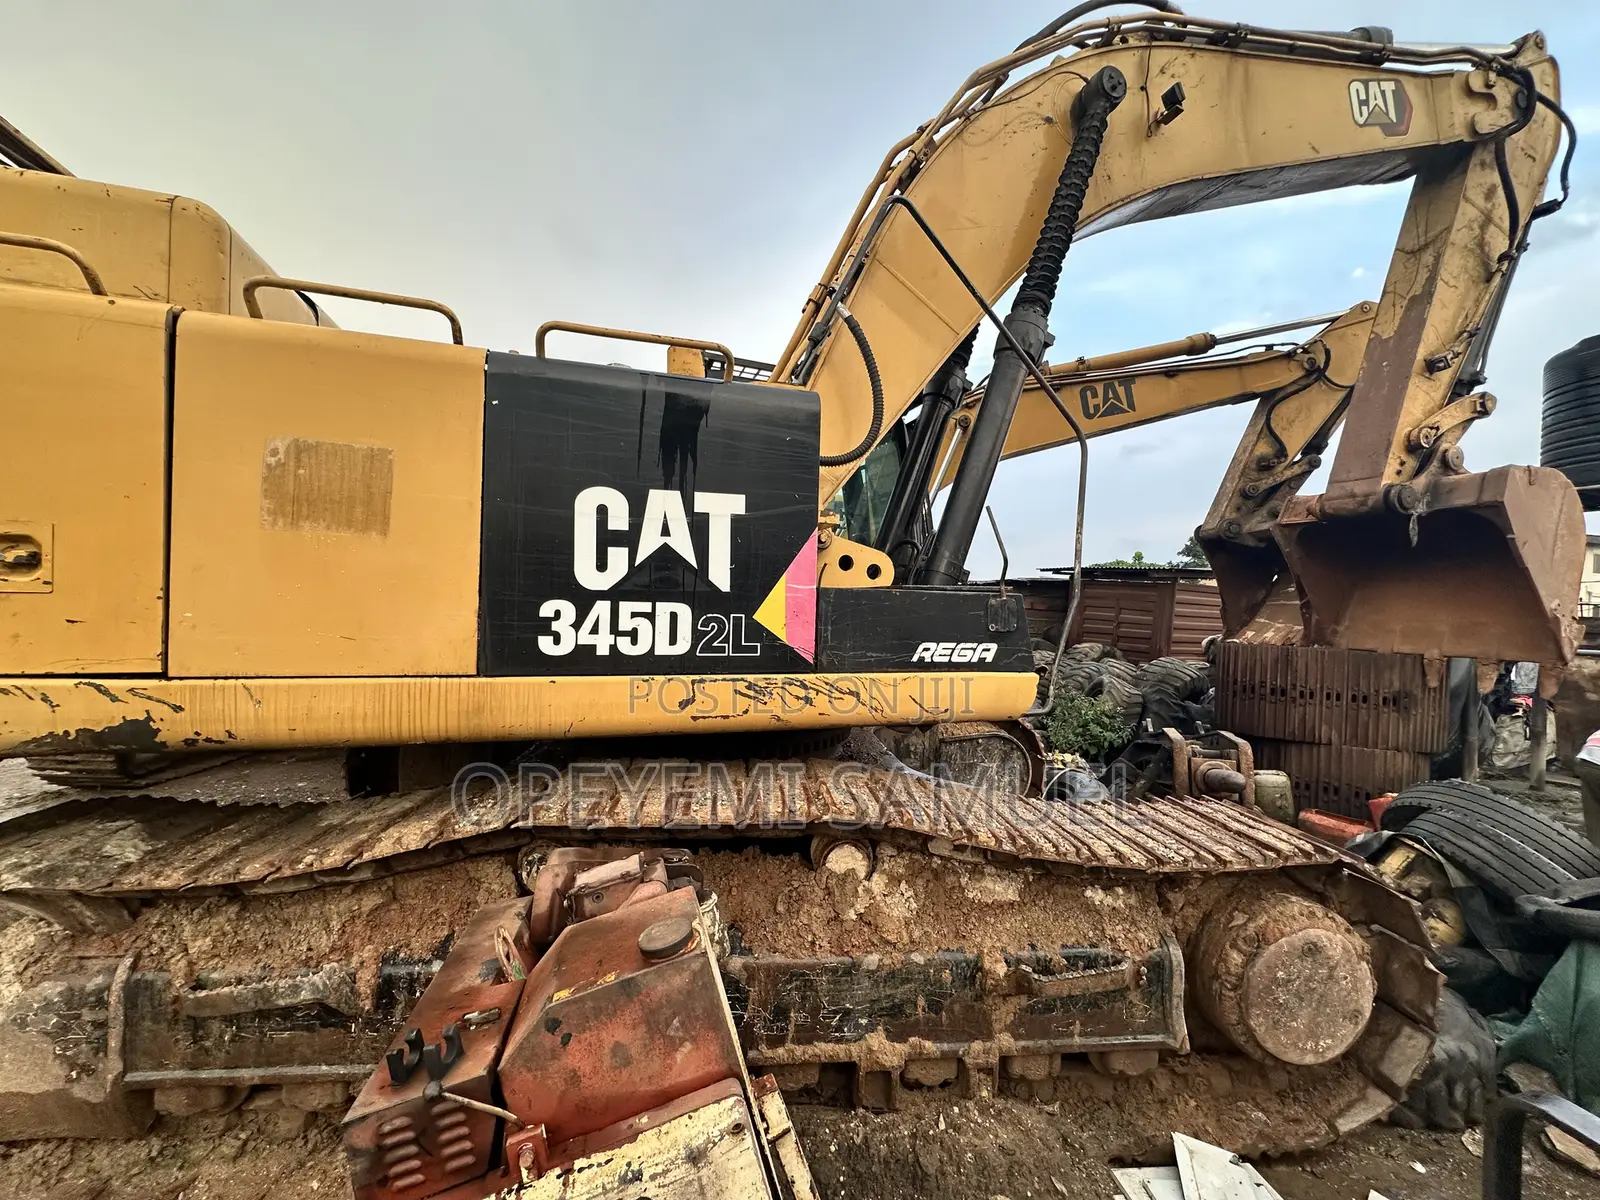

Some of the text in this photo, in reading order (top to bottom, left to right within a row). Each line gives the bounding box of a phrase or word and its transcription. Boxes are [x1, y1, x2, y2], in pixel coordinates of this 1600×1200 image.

[1349, 80, 1397, 125] CAT
[1079, 377, 1136, 420] CAT
[573, 485, 746, 593] CAT
[910, 641, 999, 664] REGA
